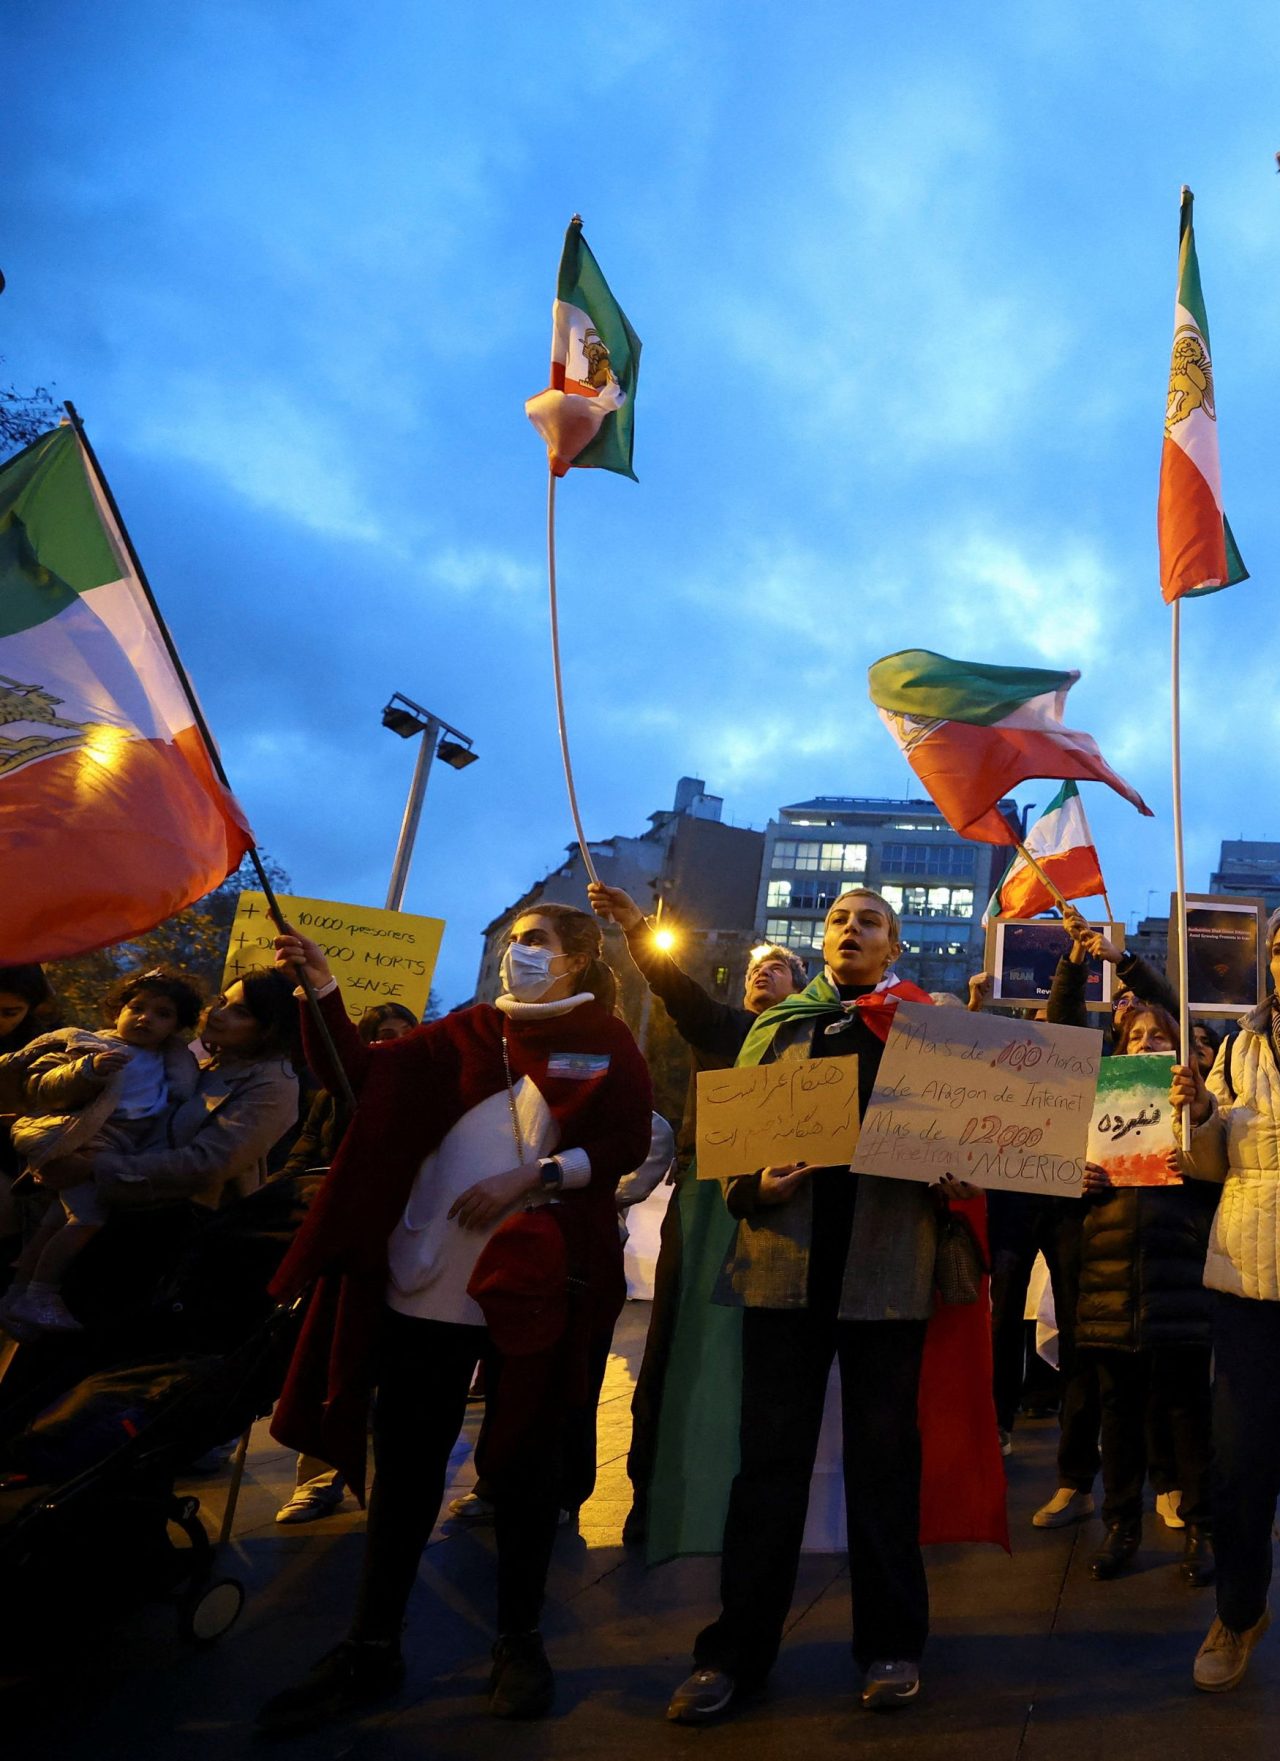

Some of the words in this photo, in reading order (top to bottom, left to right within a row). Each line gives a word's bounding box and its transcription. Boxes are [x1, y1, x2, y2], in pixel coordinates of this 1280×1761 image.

[364, 952, 426, 976] MORTS
[346, 976, 405, 997] SENSE
[961, 1040, 984, 1061] de
[1046, 1042, 1094, 1075] horas
[882, 1075, 912, 1098] de
[994, 1086, 1014, 1103] de
[1020, 1082, 1083, 1112] Internet
[920, 1120, 945, 1141] de
[970, 1152, 1083, 1185] MUERTOS
